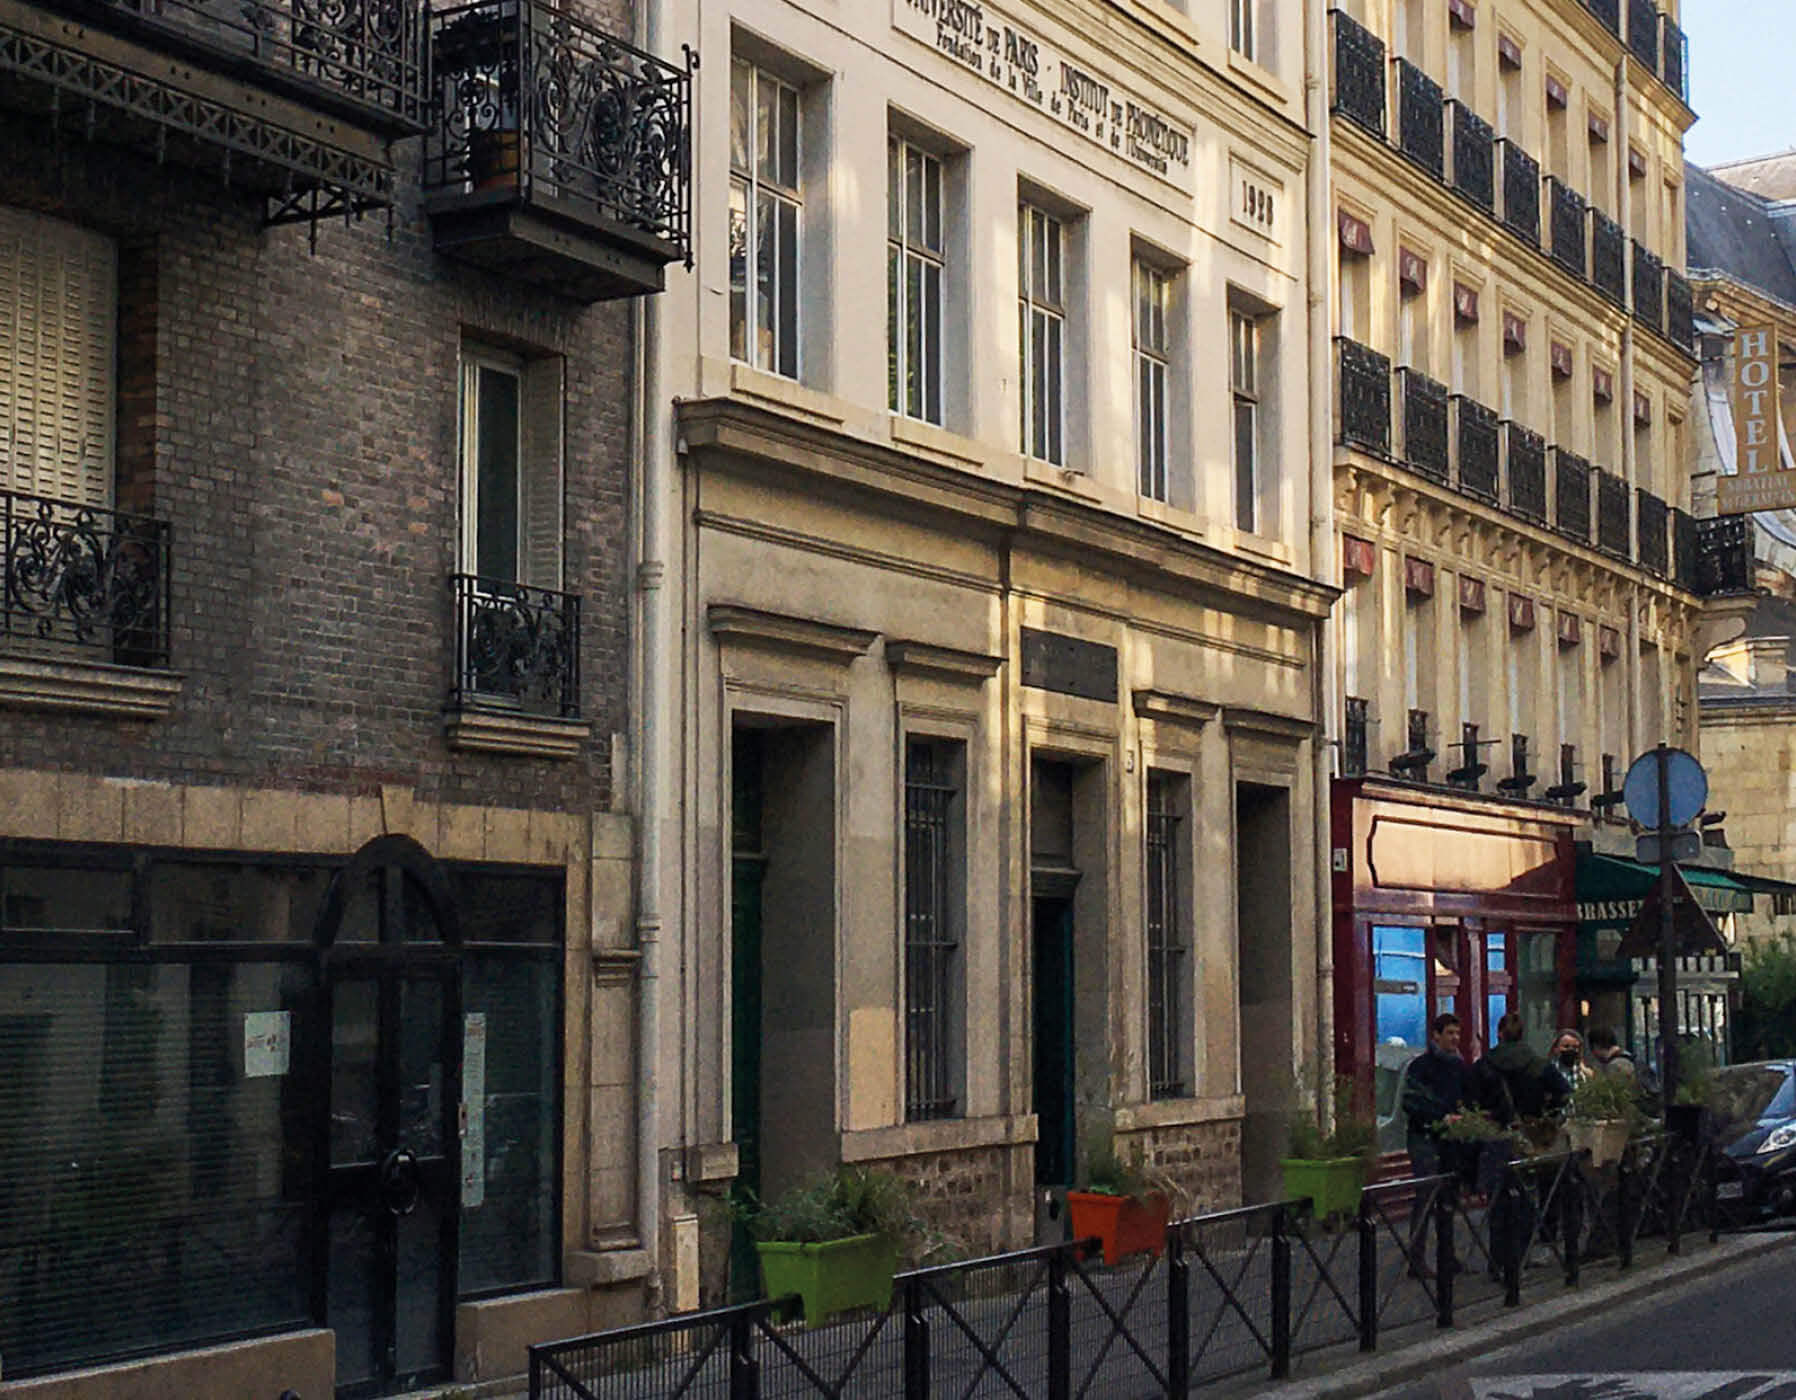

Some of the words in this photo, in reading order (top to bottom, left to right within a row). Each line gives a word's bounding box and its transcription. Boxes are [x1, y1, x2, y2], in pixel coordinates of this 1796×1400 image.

[936, 22, 982, 70] Fondation
[990, 55, 1001, 80] de
[1008, 65, 1017, 90] la
[1022, 71, 1042, 105] Ville
[1051, 90, 1061, 115] de
[1067, 98, 1089, 131] Paris
[1110, 126, 1121, 149] de
[986, 26, 1001, 55] DE
[1004, 26, 1039, 76] PARIS
[1060, 60, 1109, 118] INSTITUT
[1111, 100, 1123, 127] DE
[1125, 101, 1189, 166] PHONÉTIQUE
[1242, 180, 1273, 226] 1928
[1741, 331, 1769, 475] HOTEL
[1576, 899, 1645, 921] BRASSE
